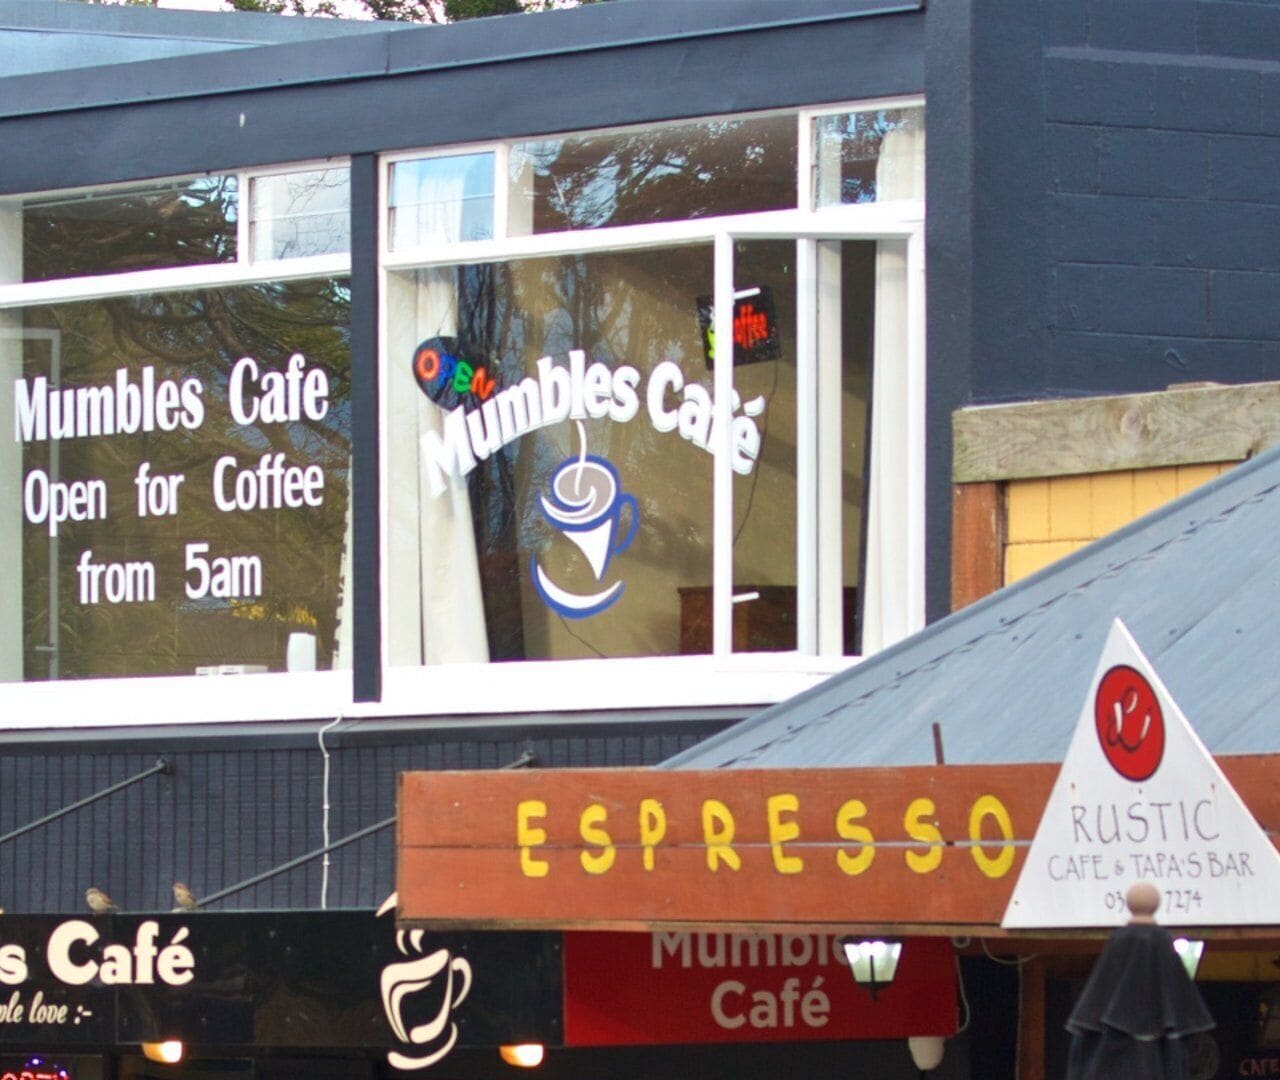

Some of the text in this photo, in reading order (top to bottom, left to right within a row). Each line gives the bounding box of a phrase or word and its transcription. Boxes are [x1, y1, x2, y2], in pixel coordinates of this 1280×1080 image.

[14, 353, 329, 443] Mumbles Cafe
[416, 348, 496, 401] OPEN
[420, 349, 766, 496] Mumbles Café
[24, 453, 324, 538] Open for Coffee
[79, 544, 263, 605] from 5am
[518, 794, 1015, 878] ESPRESSO
[1071, 799, 1219, 844] RUSTIC
[1048, 855, 1108, 881] CAFE
[1131, 852, 1203, 879] TAPA'S
[1208, 852, 1255, 878] BAR
[1165, 890, 1203, 912] 7274
[46, 919, 195, 986] Café
[29, 992, 69, 1024] love
[710, 976, 830, 1029] Café
[1239, 1058, 1280, 1077] CAFE
